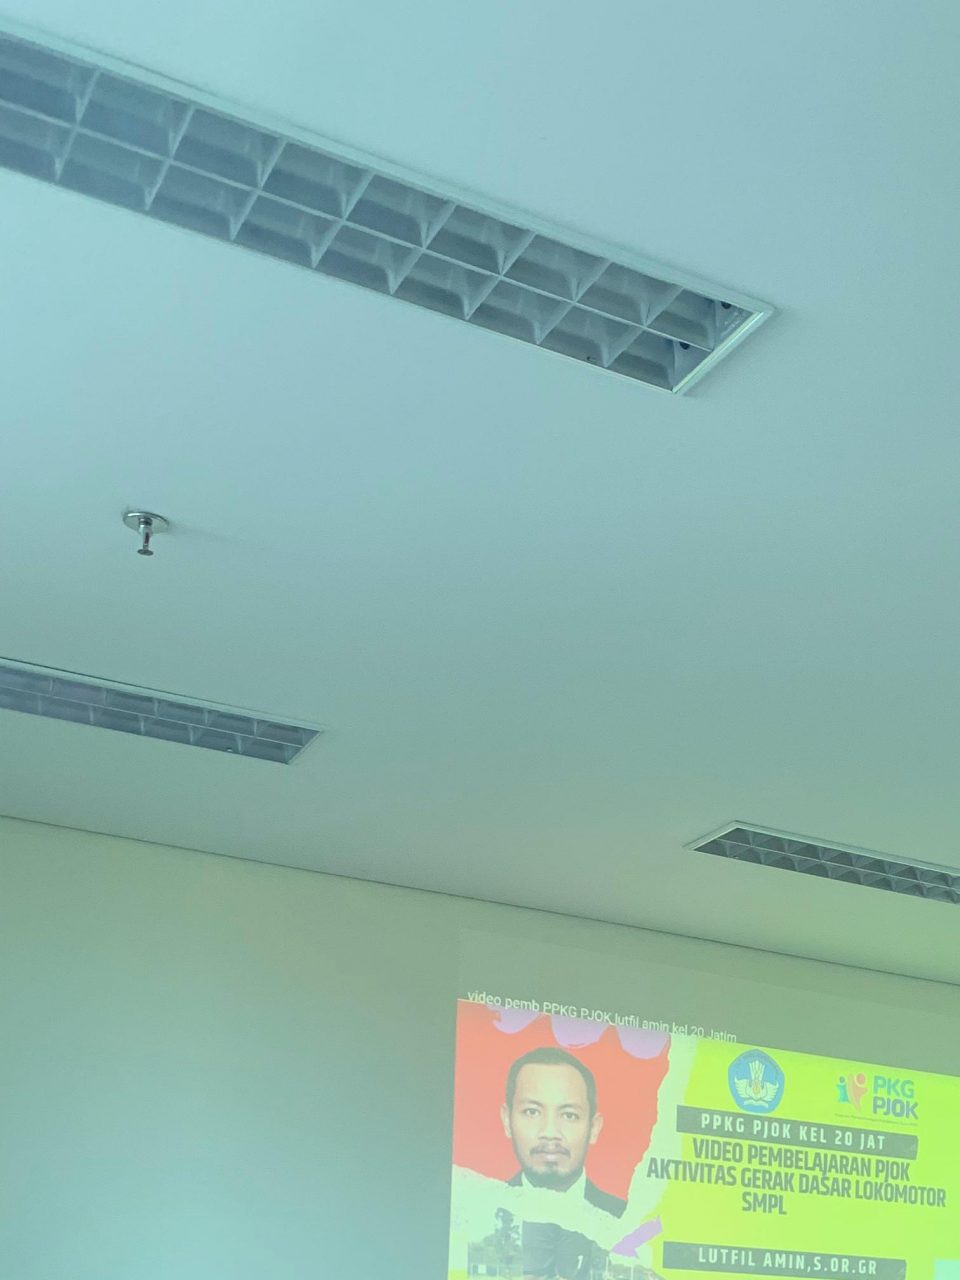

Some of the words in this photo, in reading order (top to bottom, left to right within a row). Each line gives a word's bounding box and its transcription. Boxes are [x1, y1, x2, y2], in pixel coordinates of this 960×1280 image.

[467, 990, 501, 1006] video
[505, 997, 540, 1013] pemb
[543, 1001, 577, 1018] PPKG
[580, 1007, 612, 1024] PJOK
[614, 1013, 639, 1028] lutfil
[642, 1019, 669, 1033] amin
[672, 1022, 688, 1036] kel
[691, 1026, 705, 1038] 20
[873, 1075, 914, 1099] PKG
[872, 1096, 919, 1120] PJOK
[701, 1113, 745, 1133] PPKG
[753, 1118, 791, 1139] PJOK
[799, 1123, 827, 1143] KEL
[835, 1130, 853, 1146] 20
[859, 1133, 886, 1150] JAT
[692, 1137, 743, 1163] VIDEO
[747, 1144, 872, 1177] PEMBELAJARAN
[875, 1158, 910, 1182] PJOK
[646, 1157, 737, 1186] AKTIVITAS
[741, 1167, 795, 1193] GERAK
[798, 1173, 851, 1198] DASAR
[855, 1179, 946, 1207] LOKOMOTOR
[742, 1191, 787, 1215] SMPL
[698, 1247, 756, 1267] LUTFIL
